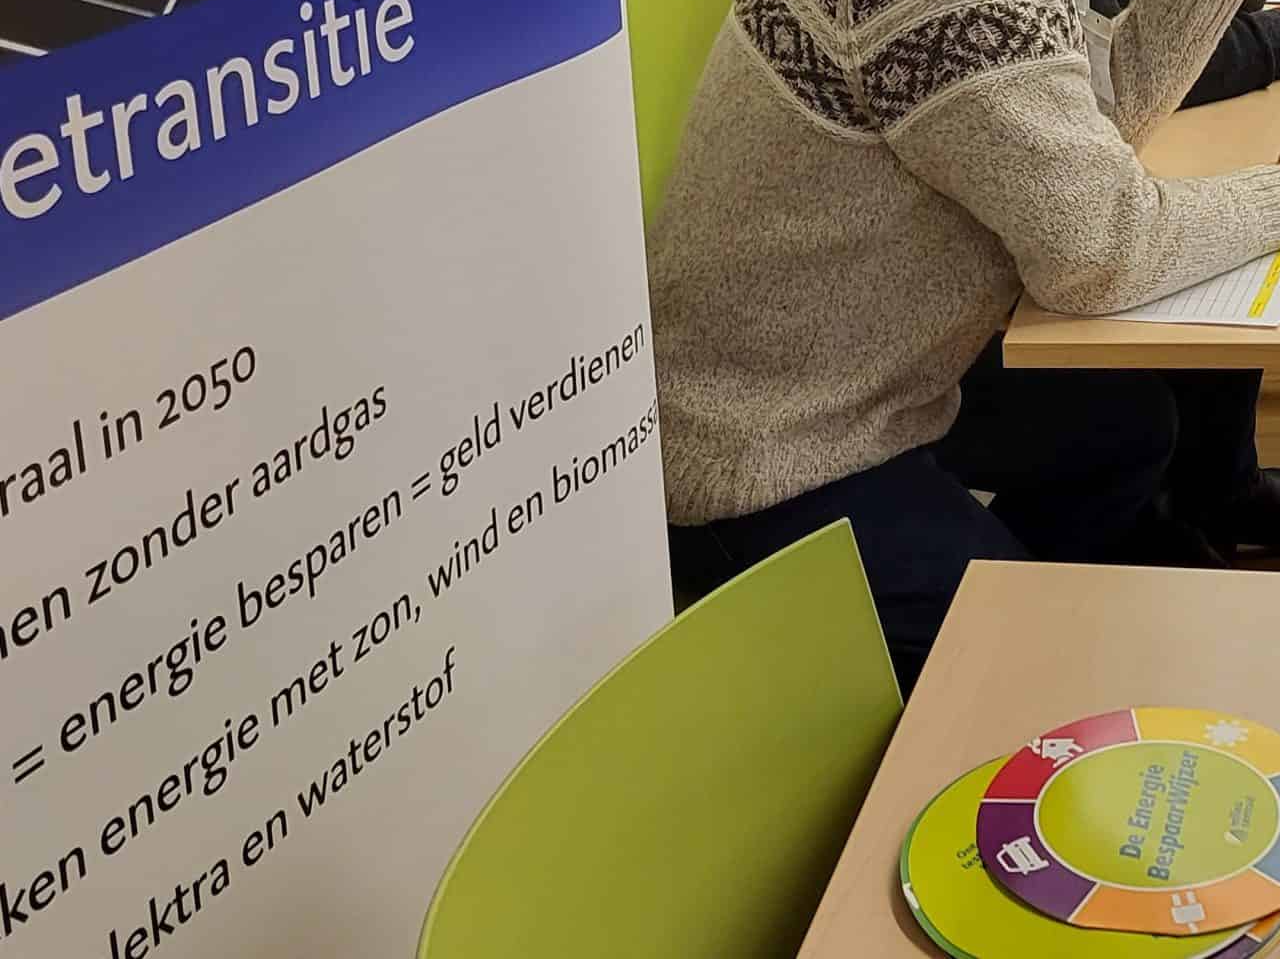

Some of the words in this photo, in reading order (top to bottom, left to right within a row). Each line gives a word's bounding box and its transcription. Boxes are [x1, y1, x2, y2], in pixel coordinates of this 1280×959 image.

[0, 419, 86, 517] raal
[100, 411, 144, 460] in
[156, 346, 257, 431] 2050
[85, 478, 240, 605] zonder
[252, 385, 387, 498] aardgas
[59, 613, 228, 754] energie
[237, 487, 402, 631] besparen
[438, 403, 502, 497] geld
[509, 322, 646, 430] verdienen
[0, 846, 87, 937] ken
[101, 712, 260, 856] energie
[271, 641, 345, 728] met
[351, 591, 422, 662] zon,
[427, 508, 500, 599] wind
[507, 490, 544, 535] en
[109, 858, 230, 959] lektra
[242, 809, 289, 867] en
[297, 646, 457, 818] waterstof
[1127, 763, 1166, 830] Energie
[1119, 830, 1144, 860] De
[1147, 749, 1201, 881] BespaarWijzer
